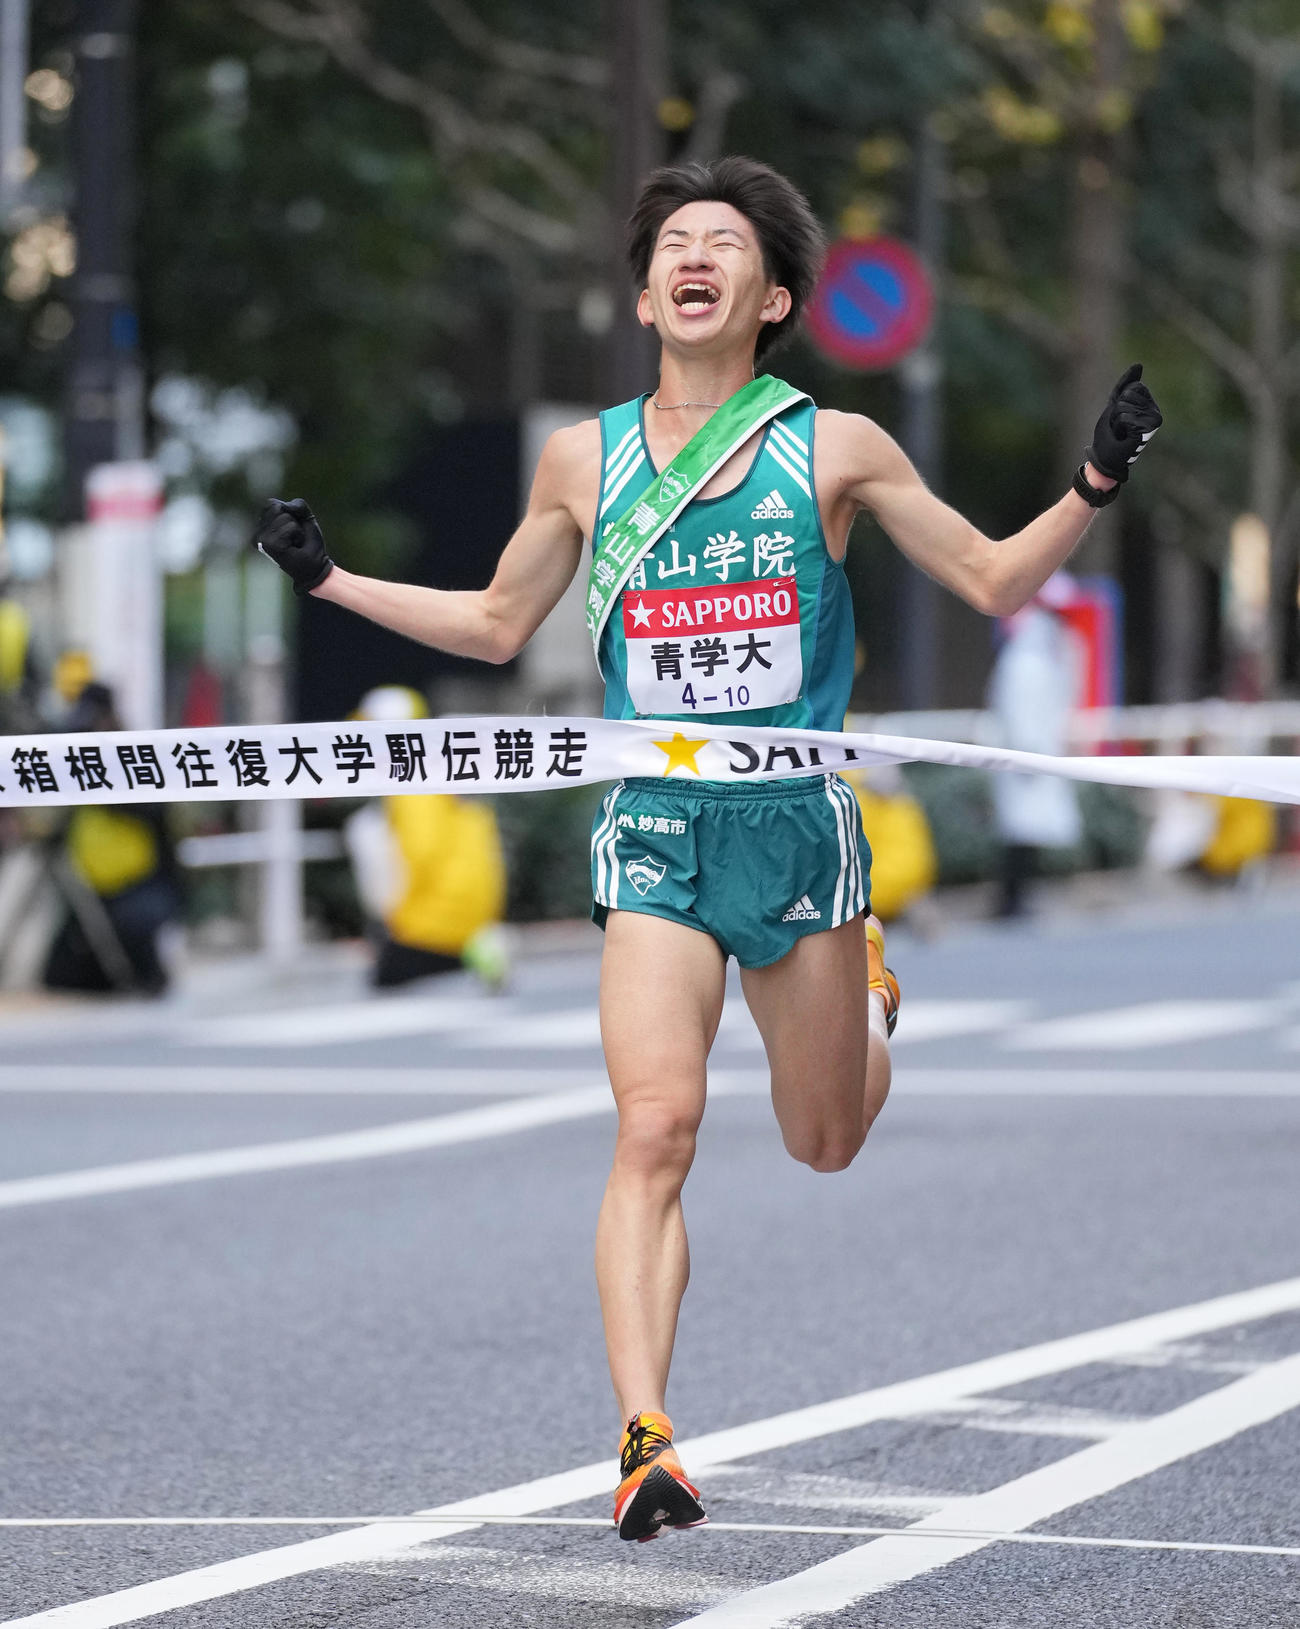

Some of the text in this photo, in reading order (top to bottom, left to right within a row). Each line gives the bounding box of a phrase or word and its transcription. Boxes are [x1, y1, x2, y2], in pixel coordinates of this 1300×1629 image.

[750, 508, 795, 521] adidas
[661, 590, 793, 628] SAPPORO
[650, 633, 773, 681] 青学大
[681, 682, 751, 709] 4-10
[0, 727, 588, 793] 箱根間往復大学駅伝競走
[638, 814, 687, 835] 妙高市
[782, 910, 821, 922] adidas
